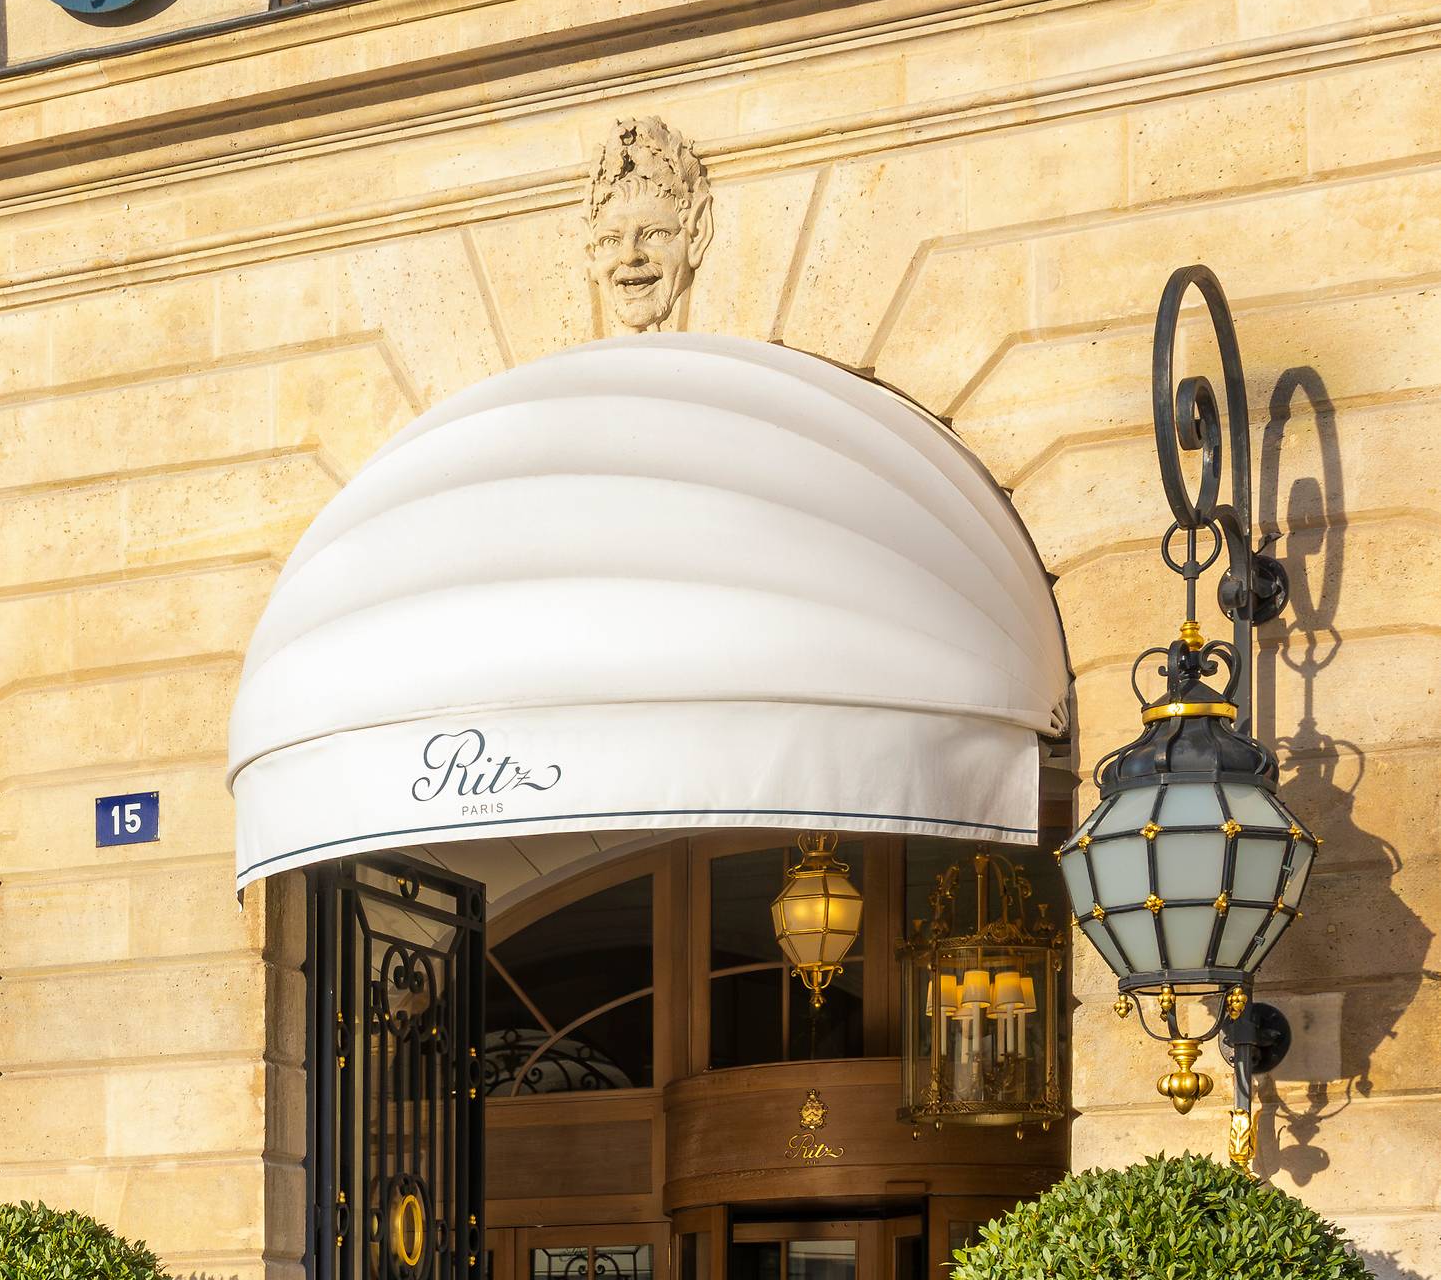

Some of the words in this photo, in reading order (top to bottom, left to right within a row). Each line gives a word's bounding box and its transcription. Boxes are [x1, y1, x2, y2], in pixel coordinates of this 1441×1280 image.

[411, 728, 562, 802] Ritz
[111, 802, 142, 836] 15
[461, 802, 504, 816] PARIS
[784, 1132, 844, 1159] Ritz
